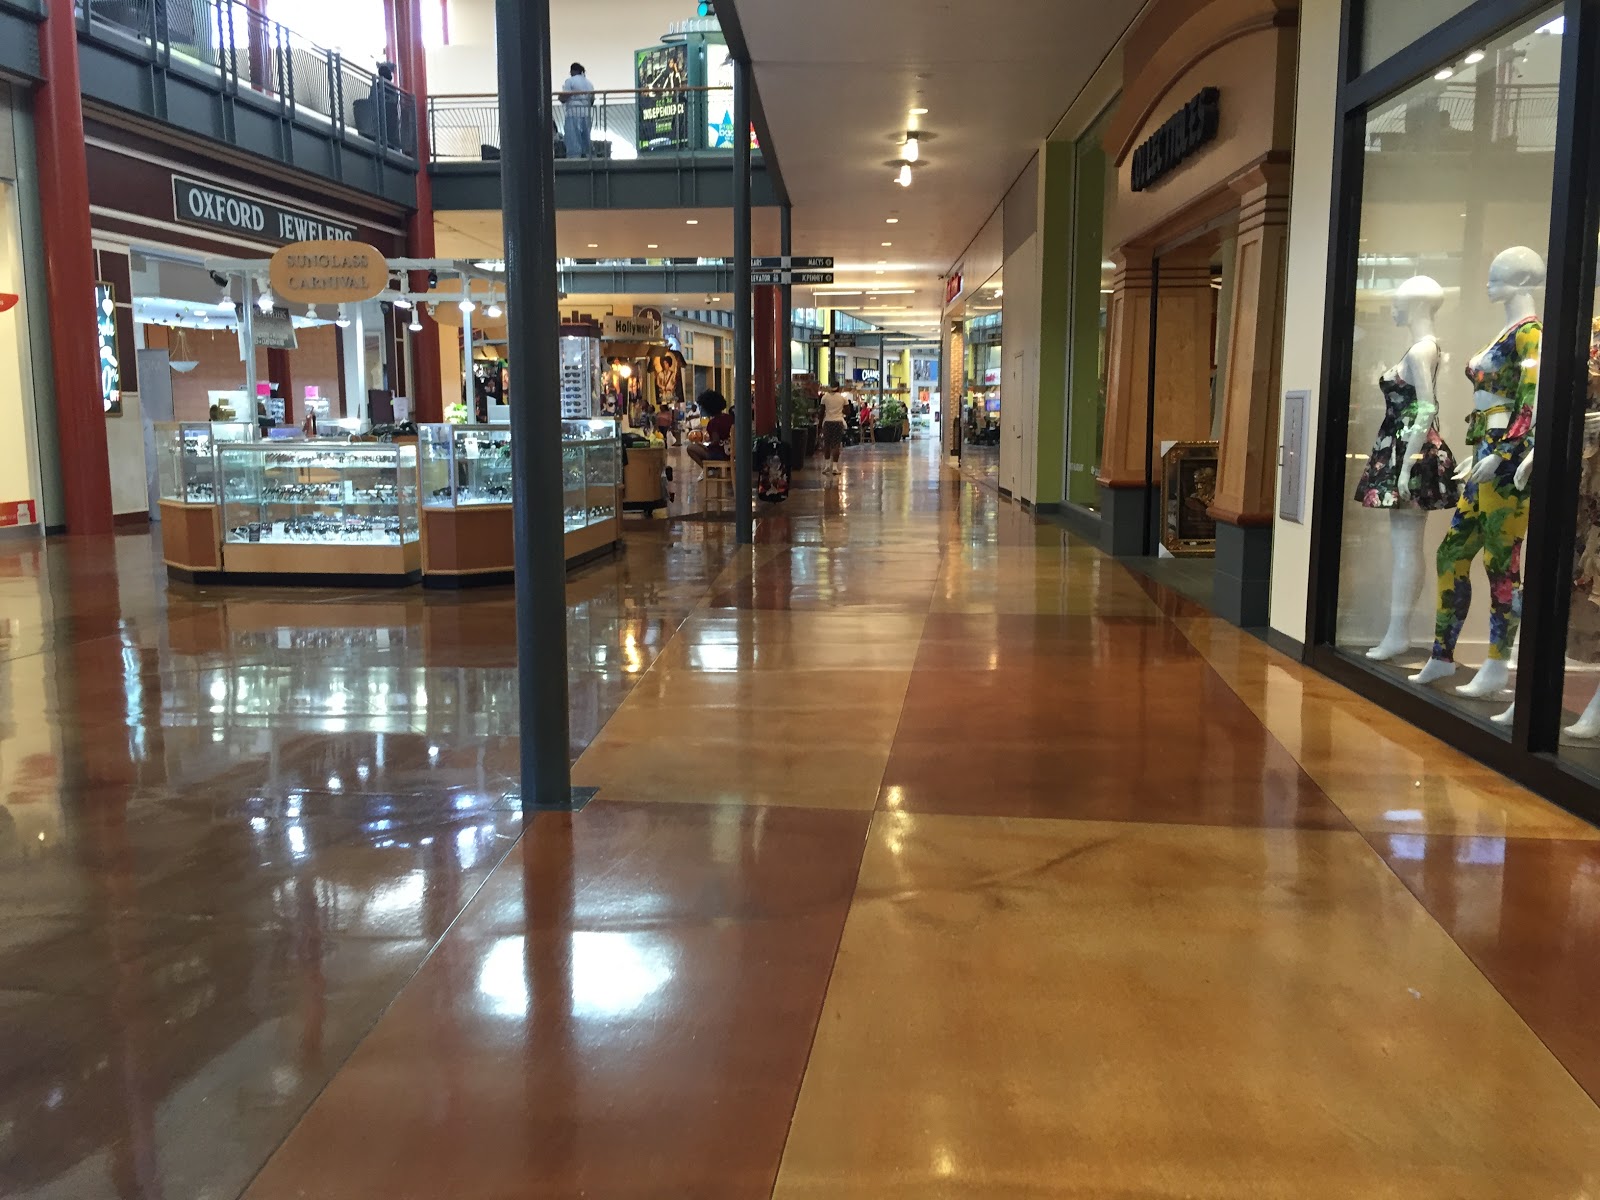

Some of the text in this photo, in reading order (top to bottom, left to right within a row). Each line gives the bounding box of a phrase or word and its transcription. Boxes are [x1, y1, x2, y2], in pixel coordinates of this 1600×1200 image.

[188, 187, 265, 232] OXFORD
[286, 255, 369, 269] SUNGLASS
[751, 258, 763, 266] EARS
[287, 276, 370, 291] CARNIVAL
